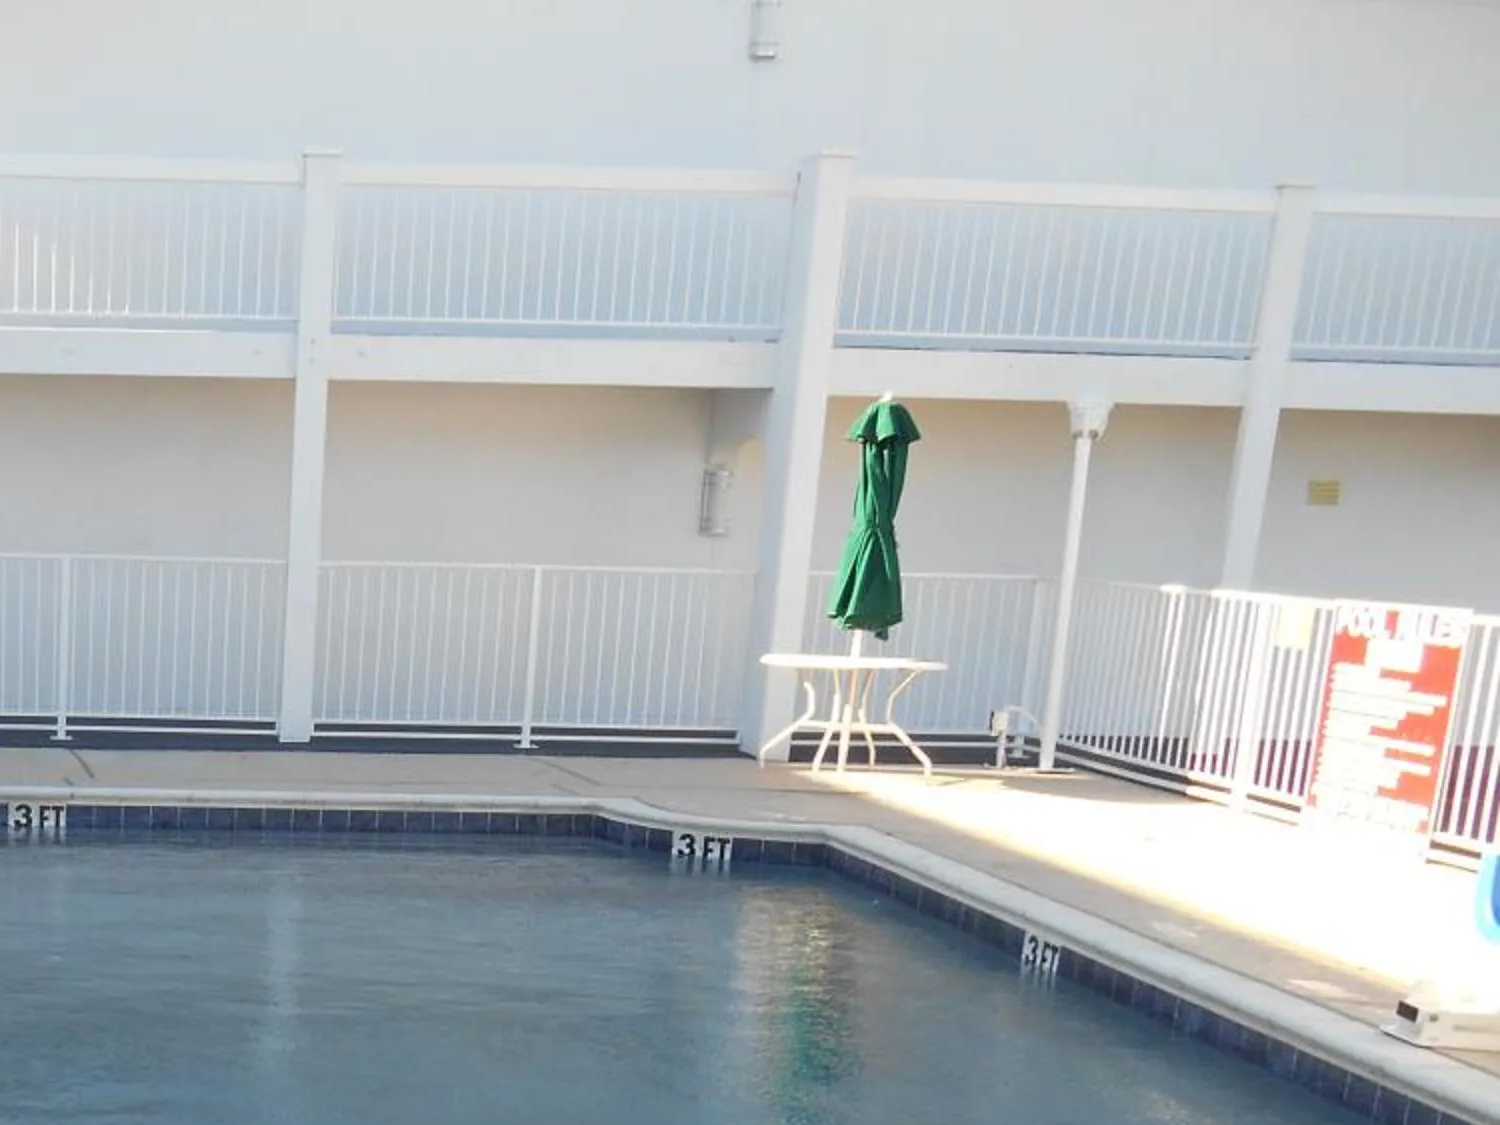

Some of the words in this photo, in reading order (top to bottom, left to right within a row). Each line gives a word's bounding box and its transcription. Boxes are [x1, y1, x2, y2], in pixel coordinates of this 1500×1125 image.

[14, 804, 32, 830] 3
[39, 805, 64, 829] FT
[678, 833, 696, 857] 3
[703, 836, 731, 858] FT
